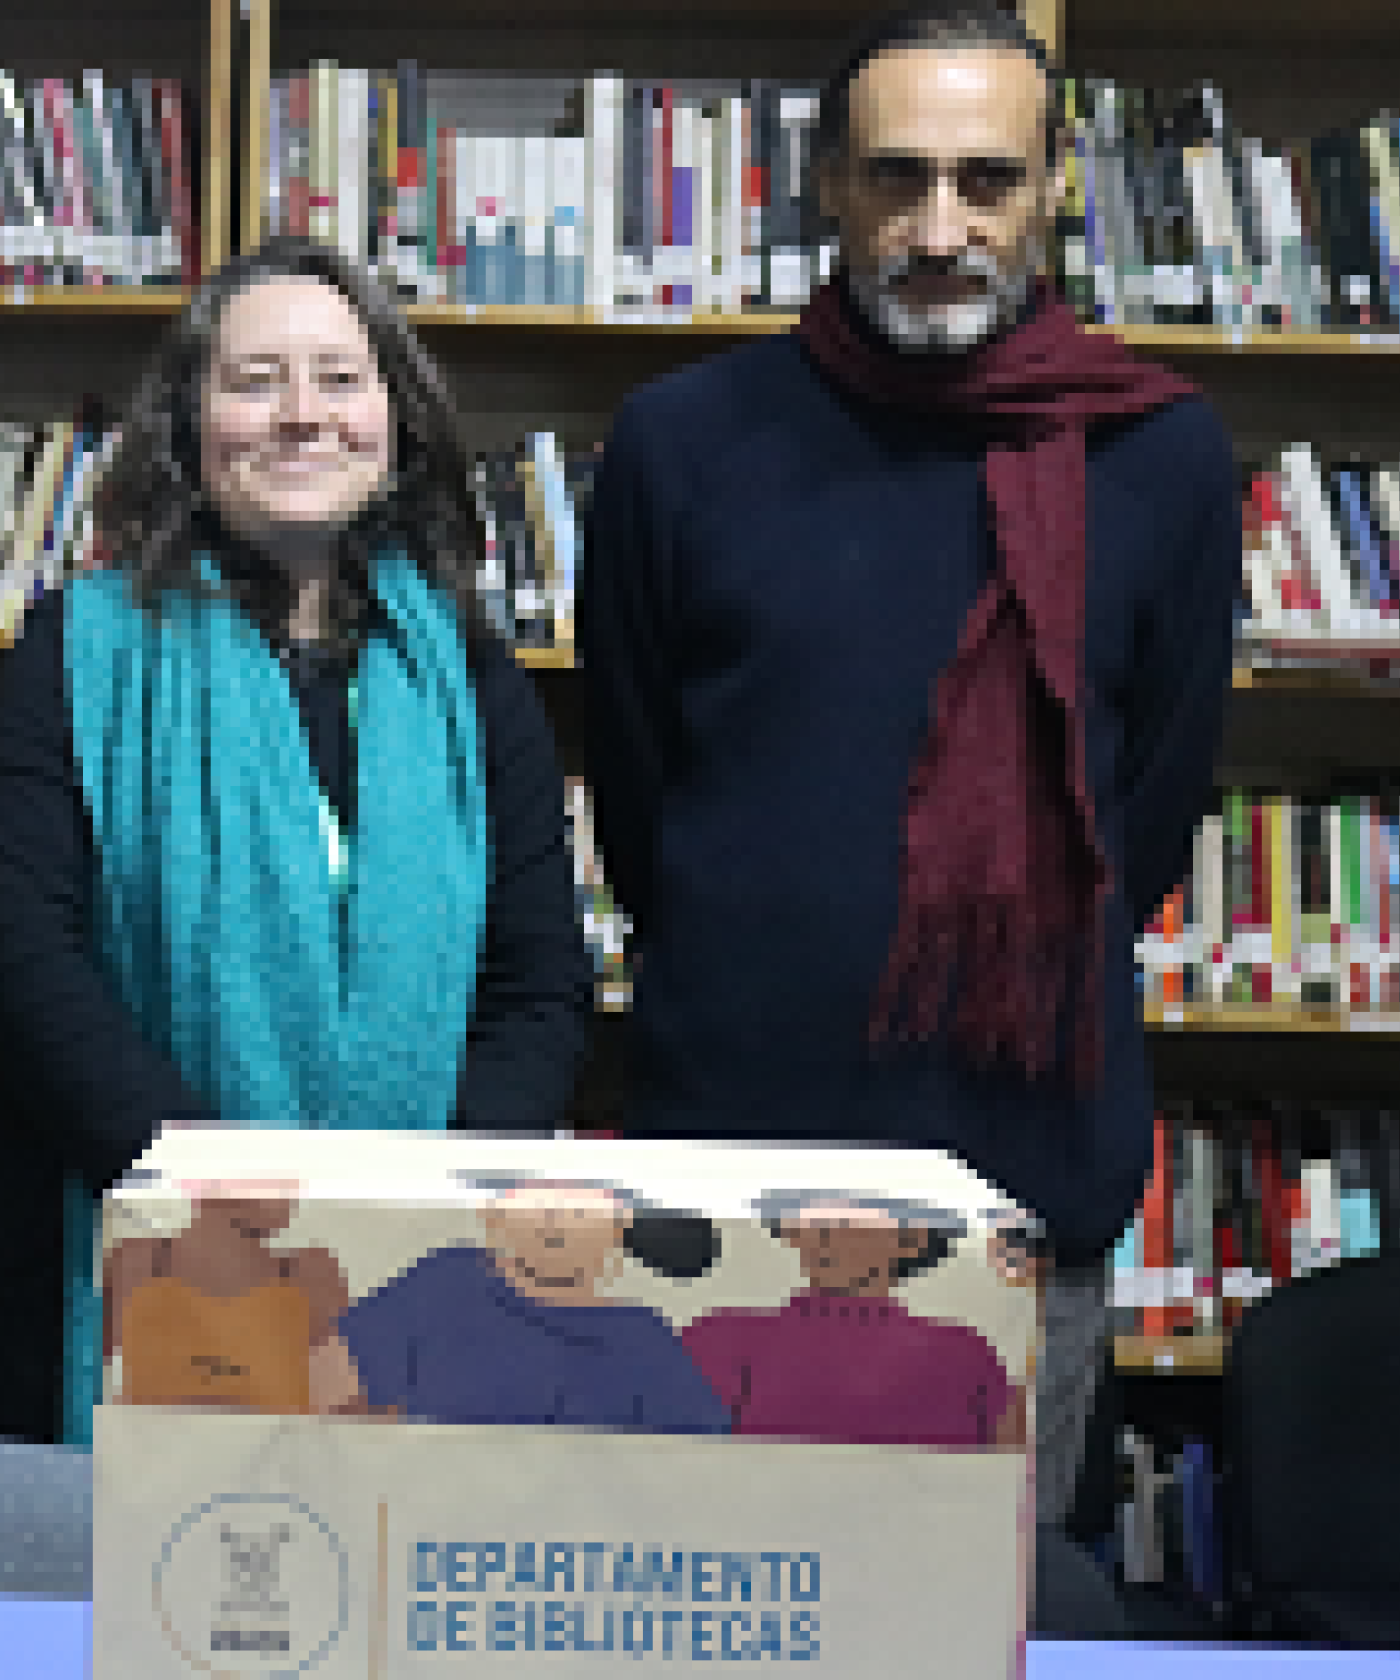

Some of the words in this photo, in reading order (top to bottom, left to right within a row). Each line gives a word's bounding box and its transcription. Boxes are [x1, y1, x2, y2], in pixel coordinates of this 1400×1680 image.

[409, 1541, 821, 1602] DEPARTAMENTO
[408, 1601, 477, 1651] DE
[486, 1602, 821, 1661] BIBLIOTECAS
